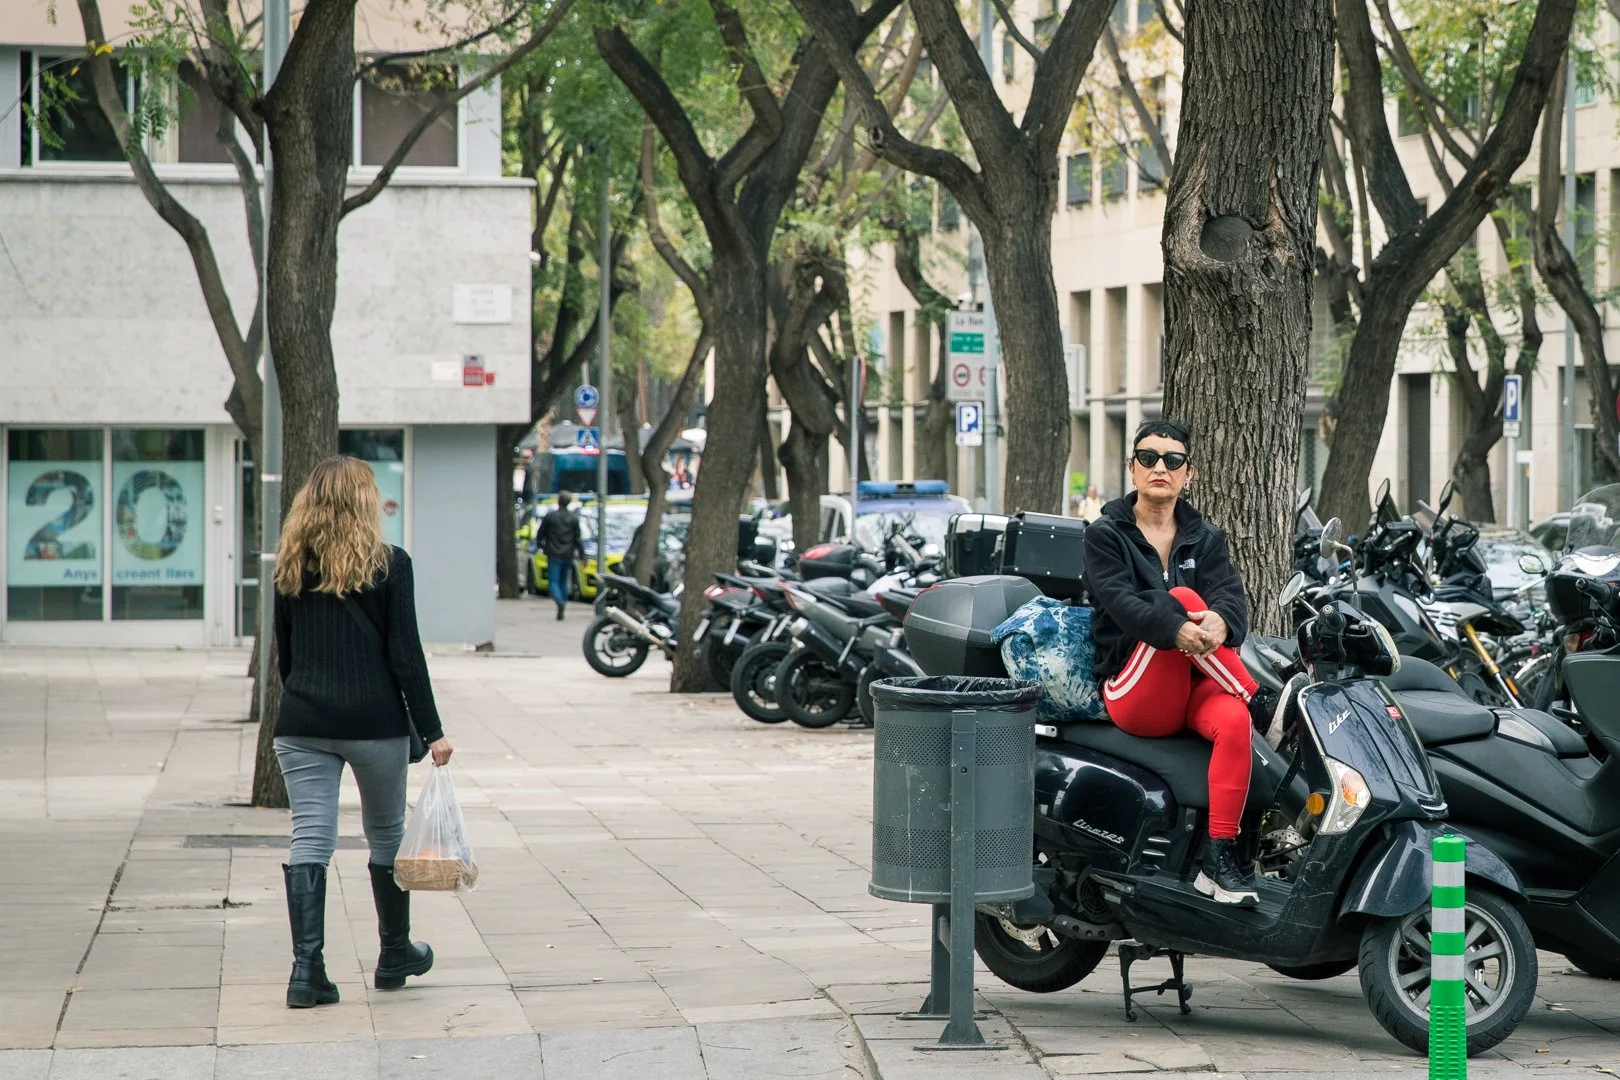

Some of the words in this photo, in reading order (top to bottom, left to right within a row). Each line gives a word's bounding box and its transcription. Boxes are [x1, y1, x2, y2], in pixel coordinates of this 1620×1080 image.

[1506, 381, 1517, 418] P
[960, 406, 977, 432] P
[24, 469, 188, 561] 20
[63, 568, 98, 580] Anys
